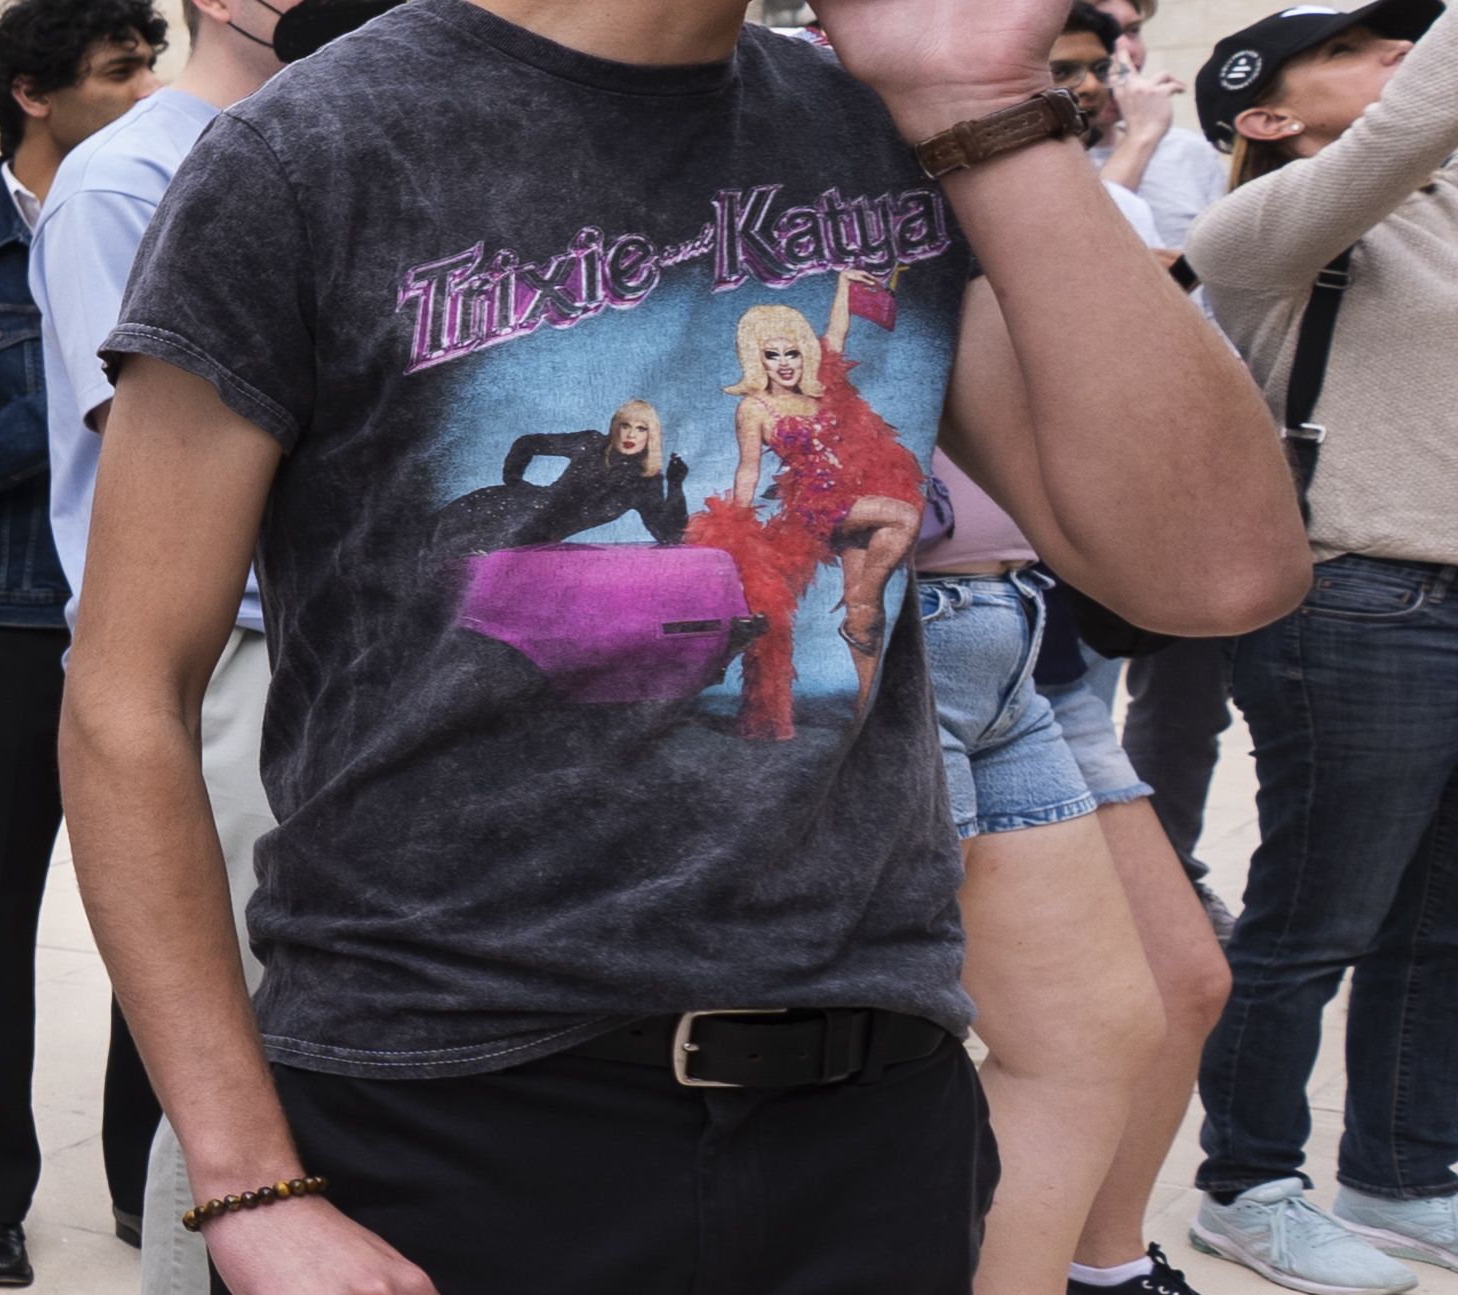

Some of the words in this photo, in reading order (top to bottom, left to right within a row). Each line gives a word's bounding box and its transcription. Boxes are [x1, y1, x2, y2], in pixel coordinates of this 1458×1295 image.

[395, 225, 660, 375] Trixie
[659, 222, 715, 267] and
[710, 183, 952, 294] Katya
